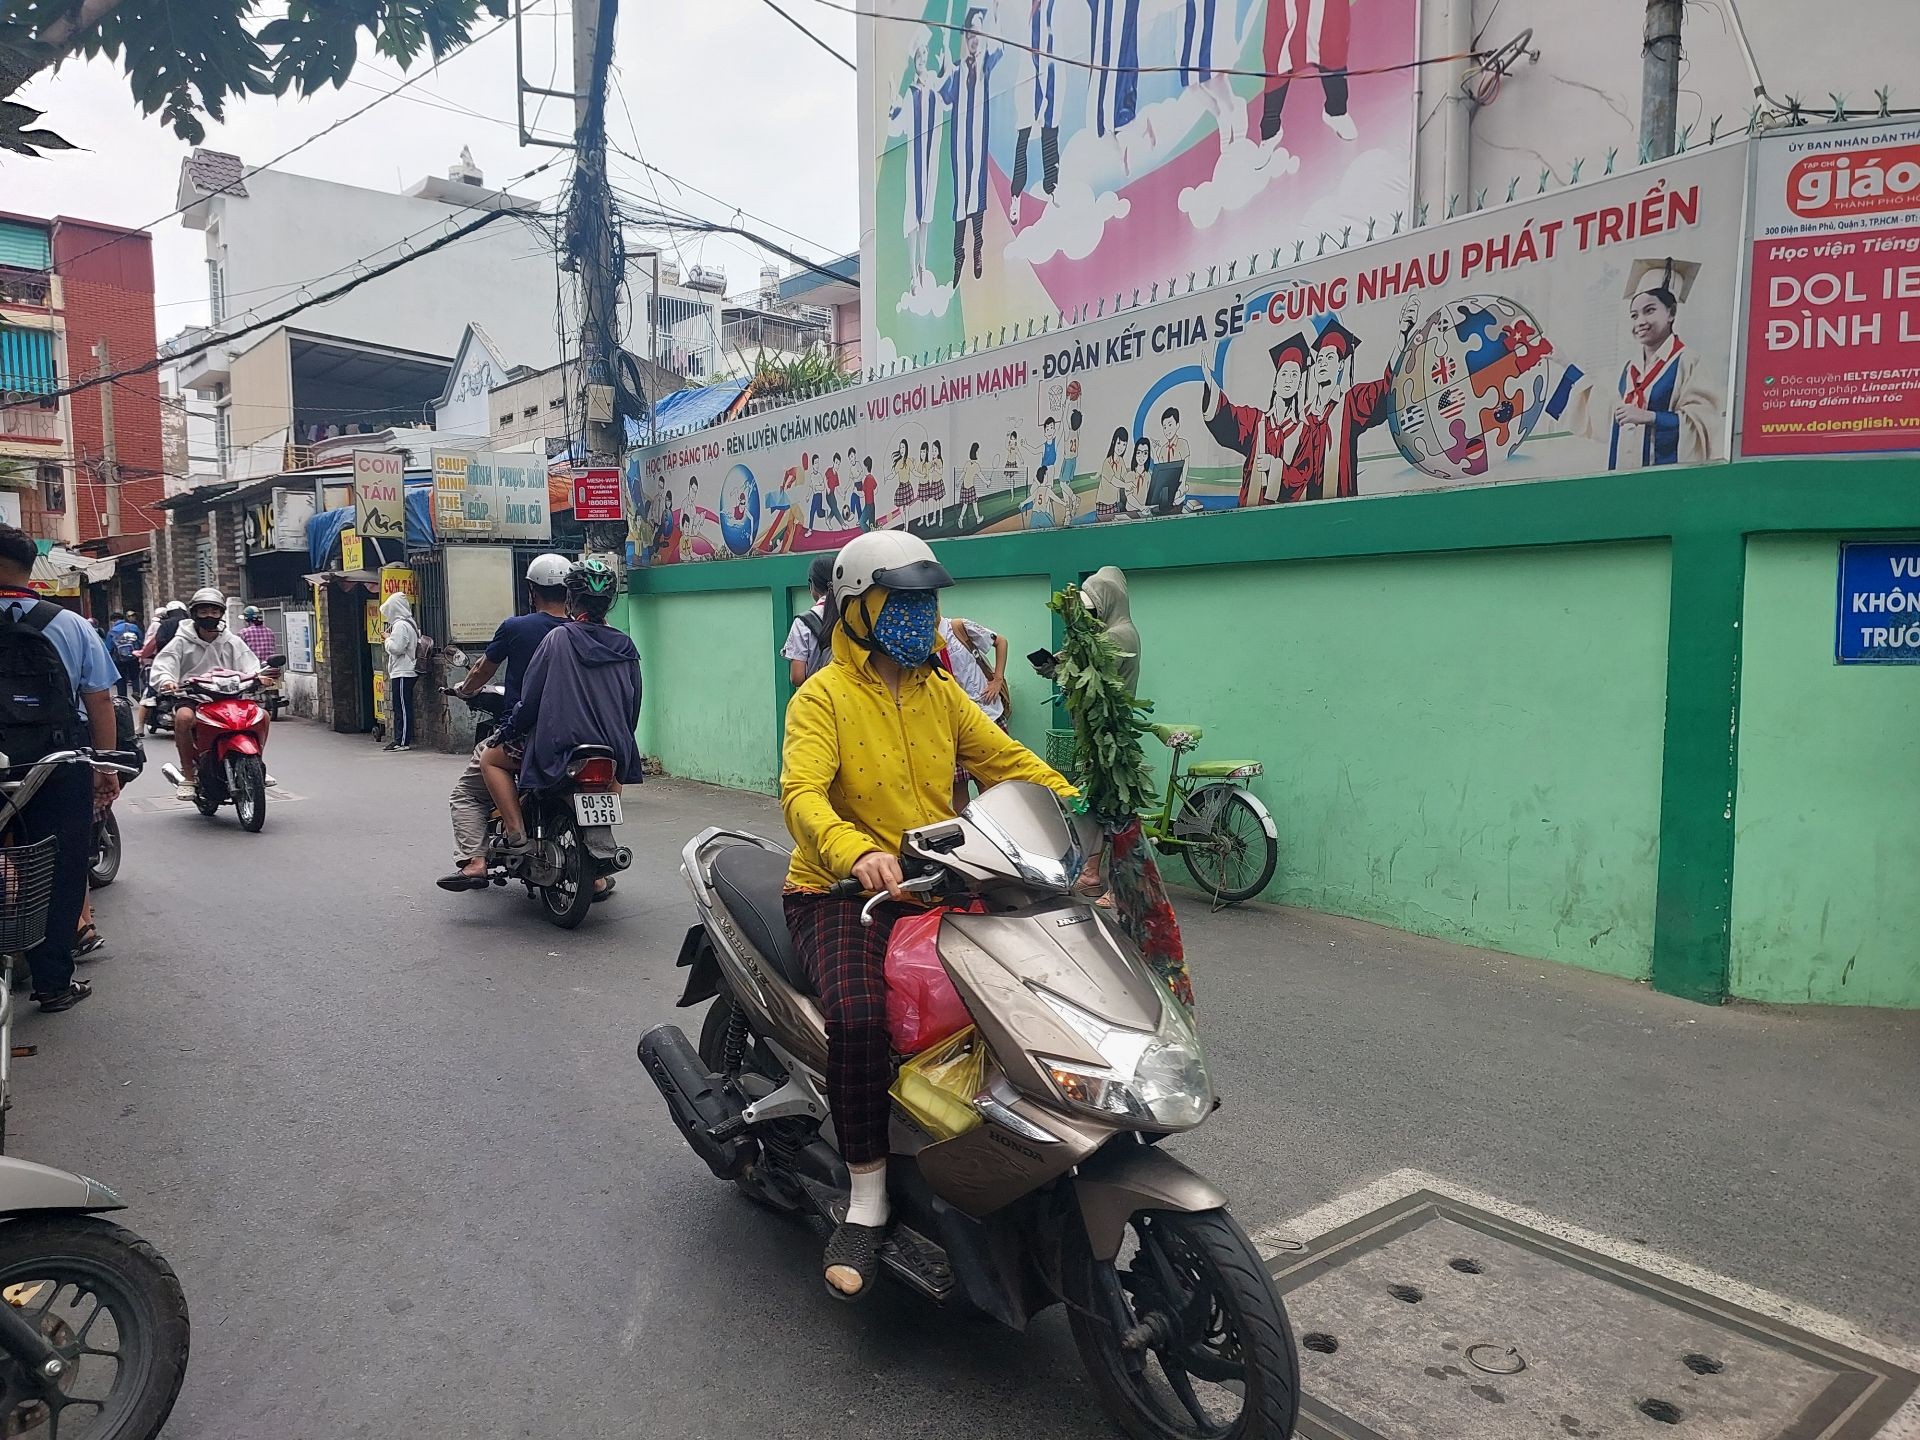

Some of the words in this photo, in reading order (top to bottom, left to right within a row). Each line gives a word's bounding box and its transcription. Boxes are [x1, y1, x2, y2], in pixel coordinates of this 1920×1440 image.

[1807, 140, 1831, 150] BAN
[1834, 136, 1869, 149] NHÂN
[1872, 133, 1898, 144] DÂN
[1797, 157, 1920, 210] giáo
[1765, 227, 1779, 235] 300
[1781, 225, 1799, 235] Điện
[1800, 223, 1817, 233] Biên
[1819, 221, 1836, 231] Phủ,
[1837, 219, 1859, 230] Quận
[1861, 220, 1868, 228] 3,
[1869, 216, 1899, 227] TP.HCM
[1770, 246, 1809, 263] Học
[1814, 242, 1856, 259] viện
[1862, 235, 1920, 252] Tiếng
[1769, 271, 1866, 307] DOL
[645, 457, 661, 481] HỌC
[662, 450, 678, 472] TẬP
[679, 447, 701, 468] SÁNG
[702, 441, 719, 466] TẠO
[726, 433, 745, 456] RÈN
[747, 423, 778, 453] LUYỆN
[780, 414, 812, 443] CHĂM
[814, 405, 857, 436] NGOAN
[867, 396, 889, 421] VUI
[892, 383, 927, 415] CHƠI
[931, 375, 972, 406] LÀNH
[976, 361, 1027, 400] MẠNH
[1042, 339, 1100, 380] ĐOÀN
[1106, 322, 1146, 364] KẾT
[1151, 315, 1208, 353] CHIA
[1213, 293, 1245, 338] SẺ
[1268, 278, 1348, 325] CÙNG
[1356, 250, 1450, 304] NHAU
[1461, 217, 1563, 278] PHÁT
[1572, 178, 1699, 250] TRIỂN
[1764, 310, 1881, 350] ĐÌNH
[1780, 375, 1803, 386] Độc
[1806, 372, 1841, 386] quyền
[1763, 388, 1779, 397] với
[1782, 385, 1826, 398] phương
[1828, 384, 1858, 395] pháp
[1762, 399, 1787, 411] giúp
[1790, 398, 1817, 409] tăng
[1819, 394, 1850, 406] điểm
[1852, 393, 1880, 404] thần
[1761, 417, 1920, 433] www.dolenglish.vn
[358, 456, 400, 475] CƠM
[361, 480, 397, 501] TẤM
[581, 795, 614, 809] 60-S9
[584, 810, 616, 823] 1356
